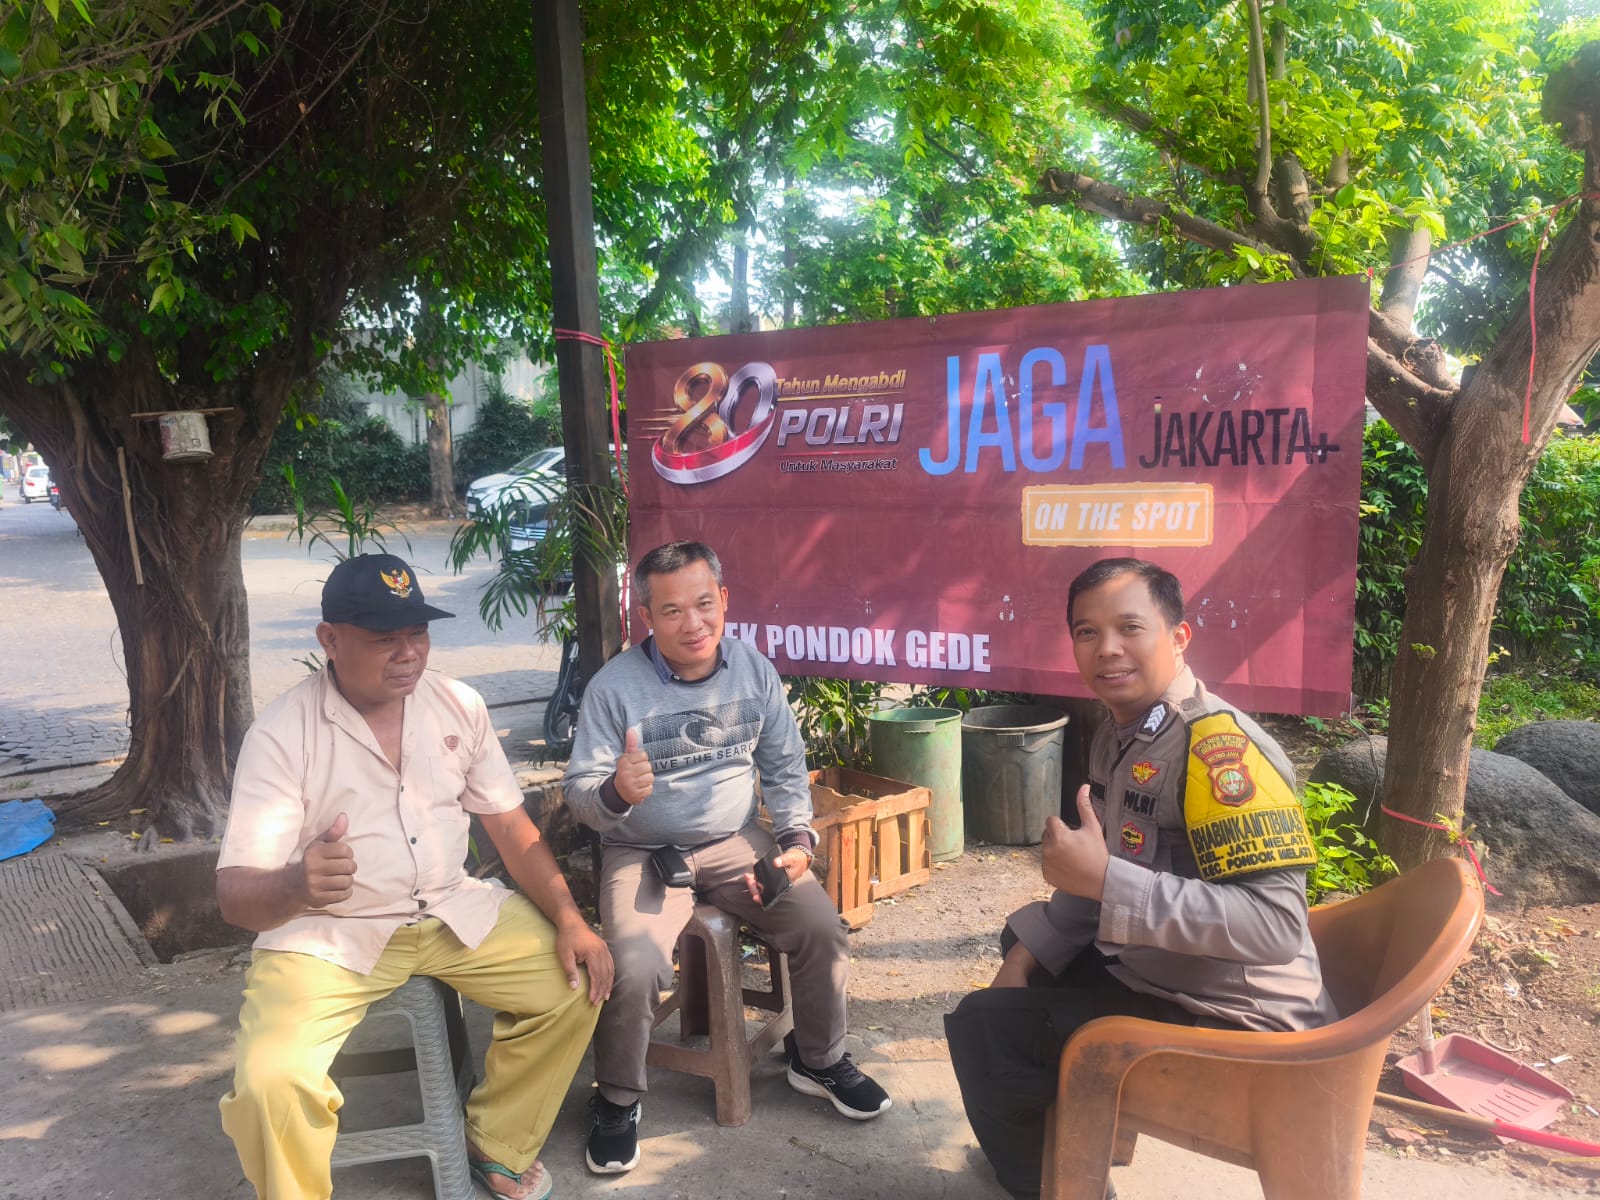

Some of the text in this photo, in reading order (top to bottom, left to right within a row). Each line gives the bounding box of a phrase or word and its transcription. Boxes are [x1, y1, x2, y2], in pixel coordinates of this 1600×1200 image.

[776, 369, 906, 395] Tahun Mengabdi
[661, 361, 777, 456] 80
[918, 344, 1126, 476] JAGA
[776, 403, 905, 447] POLRI
[780, 457, 898, 473] Untuk Masyarakat
[1034, 500, 1201, 532] ON THE SPOT
[766, 624, 897, 667] PONDOK
[904, 630, 992, 673] GEDE
[654, 758, 678, 771] IVE
[683, 752, 713, 766] THE
[1190, 808, 1304, 854] BHABINKANTIBMAS
[1199, 834, 1308, 866] KEL. JATI MELATI
[1202, 846, 1313, 878] KEC. PONDOK MELATI
